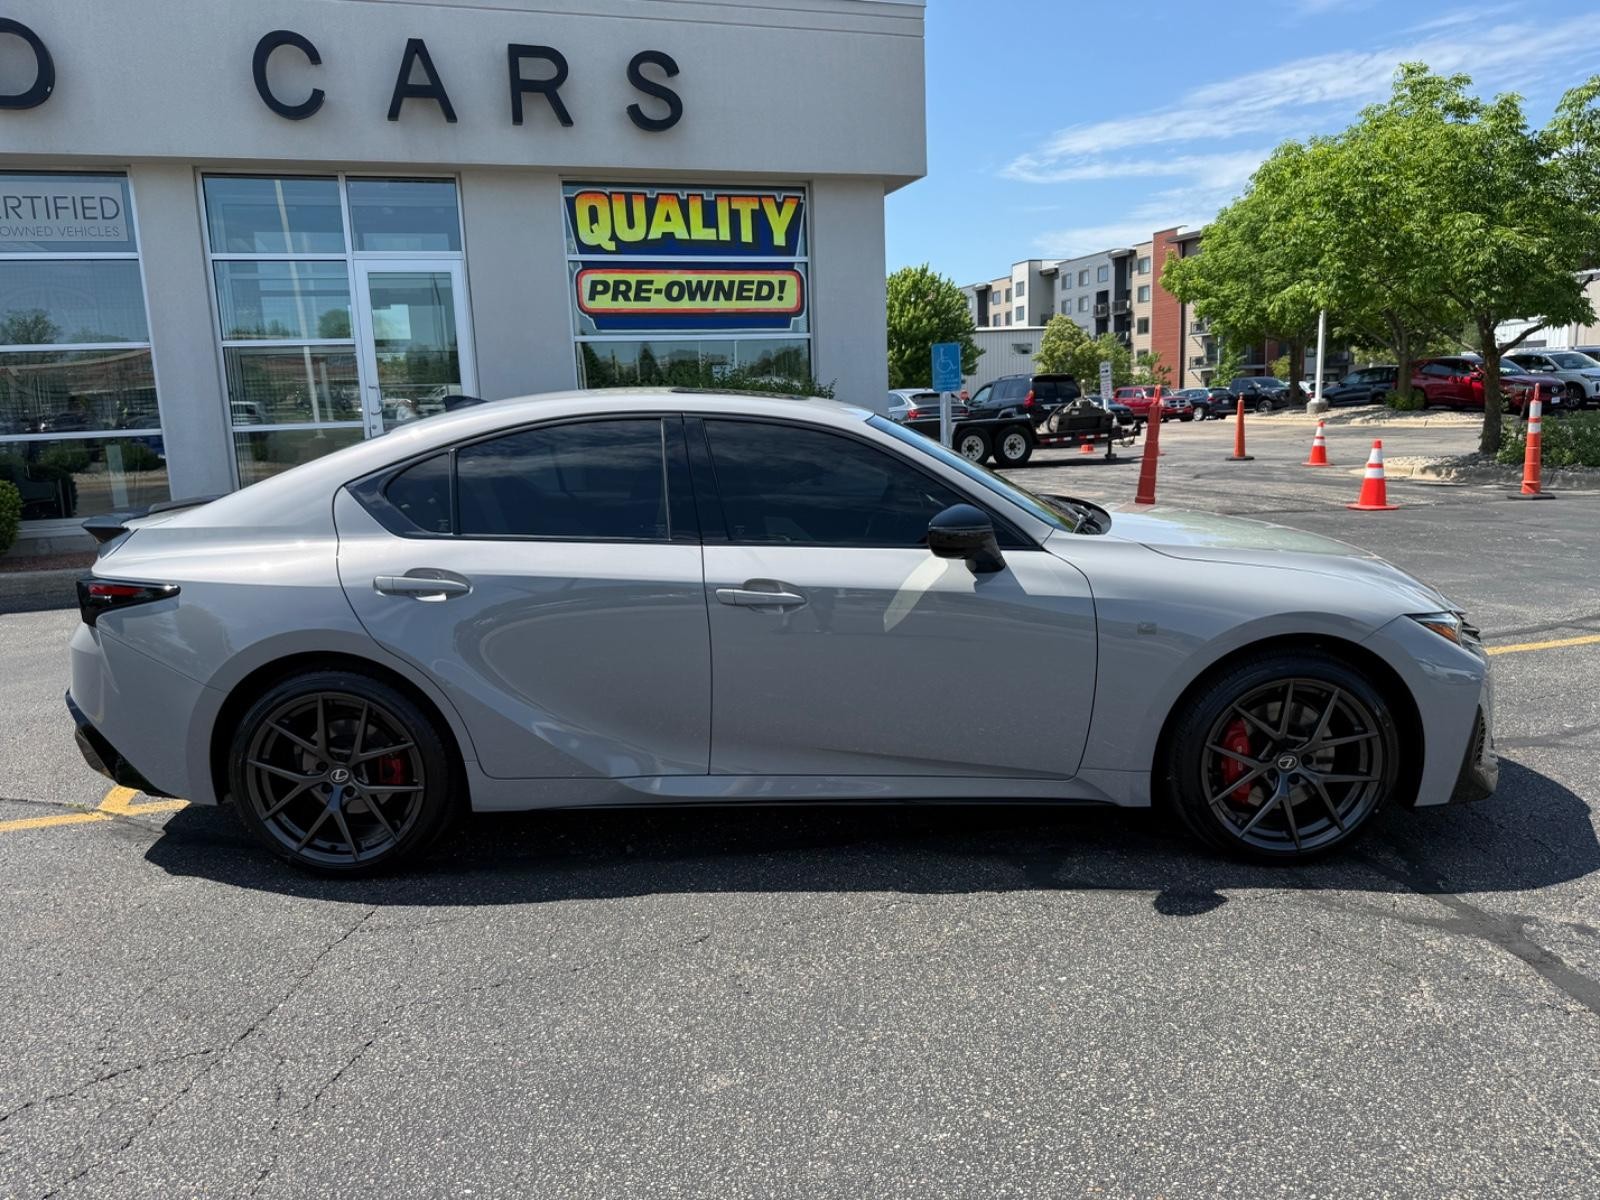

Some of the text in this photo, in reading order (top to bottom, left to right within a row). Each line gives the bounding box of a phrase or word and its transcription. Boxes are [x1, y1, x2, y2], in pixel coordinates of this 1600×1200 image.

[252, 30, 683, 132] CARS
[0, 195, 121, 220] RTIFIED
[57, 225, 121, 238] VEHICLES
[575, 191, 798, 251] QUALITY
[588, 279, 787, 303] PRE-OWNED!
